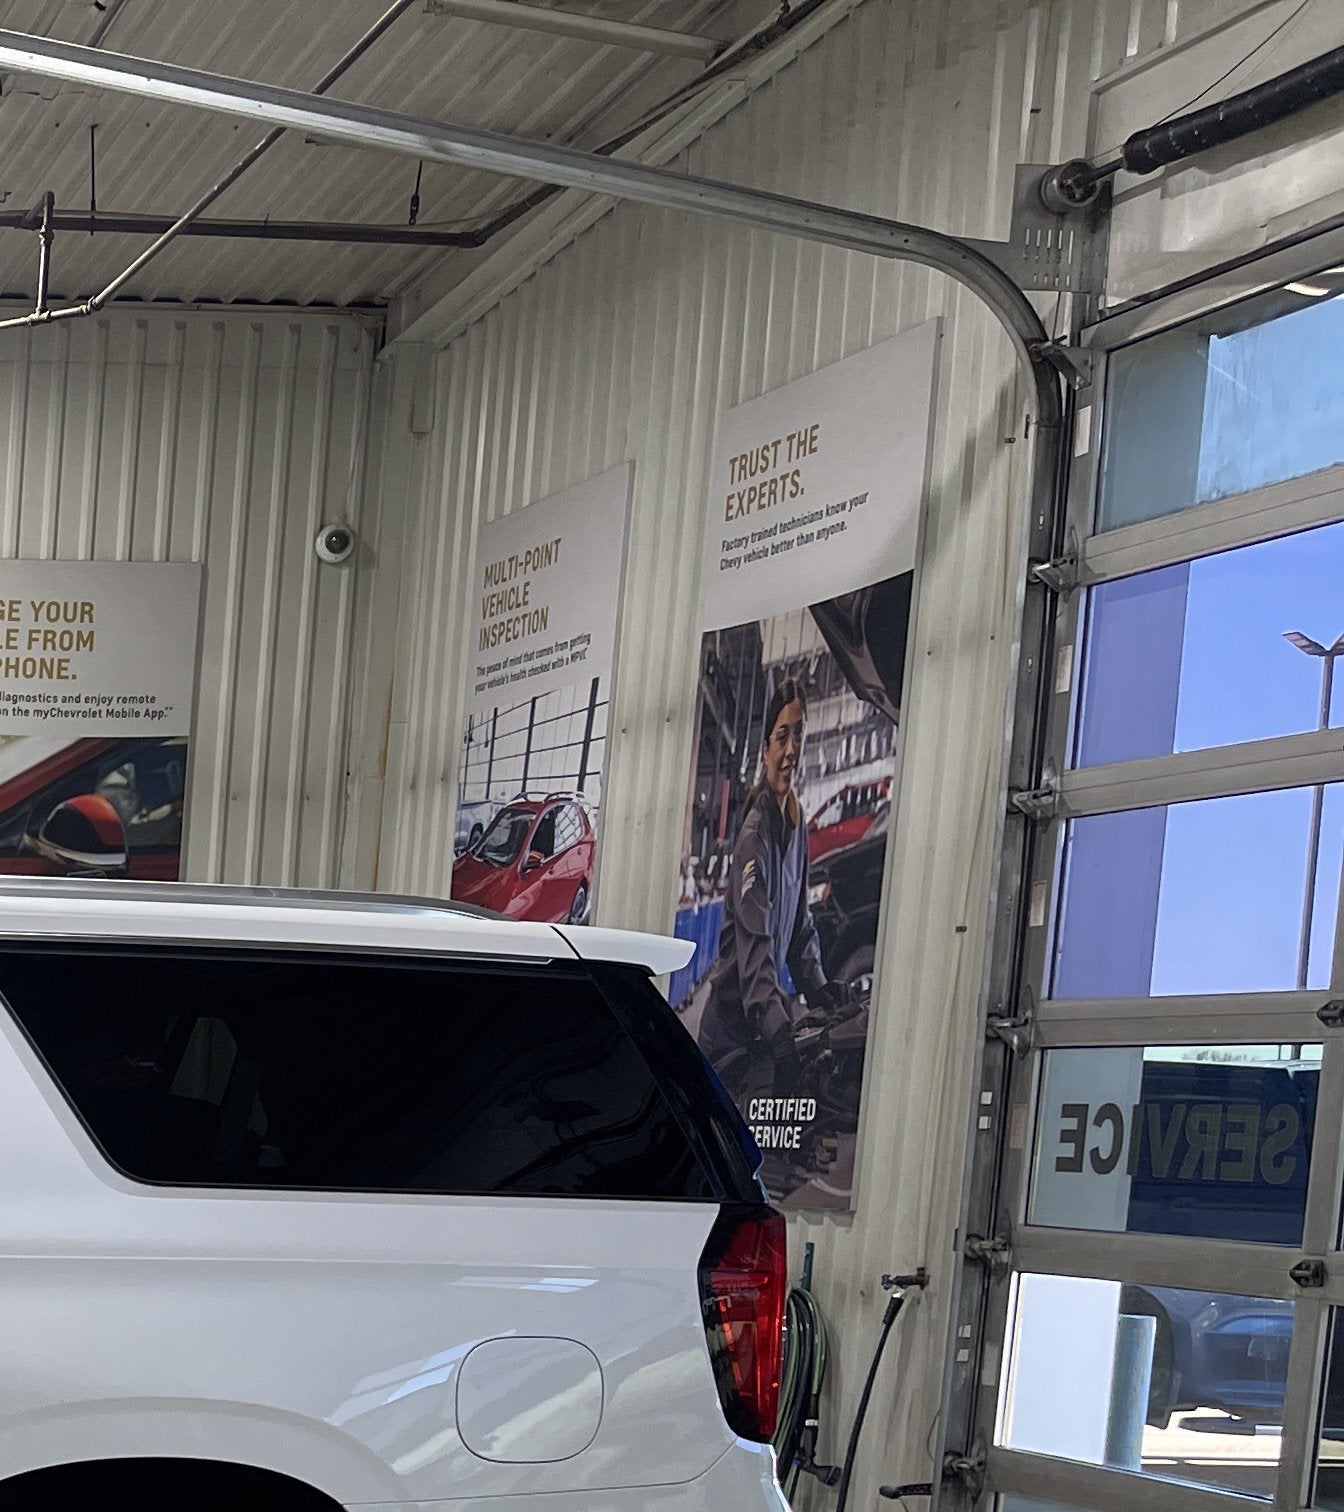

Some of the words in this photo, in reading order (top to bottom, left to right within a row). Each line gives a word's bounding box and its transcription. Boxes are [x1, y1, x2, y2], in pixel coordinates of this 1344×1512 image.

[728, 439, 781, 486] TRUST
[786, 424, 820, 461] THE
[724, 469, 805, 522] EXPERTS.
[721, 534, 750, 552] Factory
[750, 522, 778, 544] trained
[779, 508, 824, 534] technicians
[825, 500, 847, 518] know
[847, 491, 869, 513] your
[484, 537, 562, 590] MULTI-POINT
[719, 555, 742, 571] Chevy
[743, 544, 769, 564] vehicle
[770, 538, 795, 556] better
[796, 531, 814, 547] than
[815, 520, 848, 541] anyone.
[30, 600, 95, 624] YOUR
[481, 581, 530, 620] VEHICLE
[27, 629, 95, 652] FROM
[478, 606, 549, 652] INSPECTION
[12, 706, 30, 717] the
[33, 707, 103, 720] myChevrolet
[105, 708, 141, 719] Mobile
[61, 693, 81, 704] and
[84, 693, 114, 707] enjoy
[116, 694, 157, 704] remote
[749, 1098, 817, 1121] CERTIFIED
